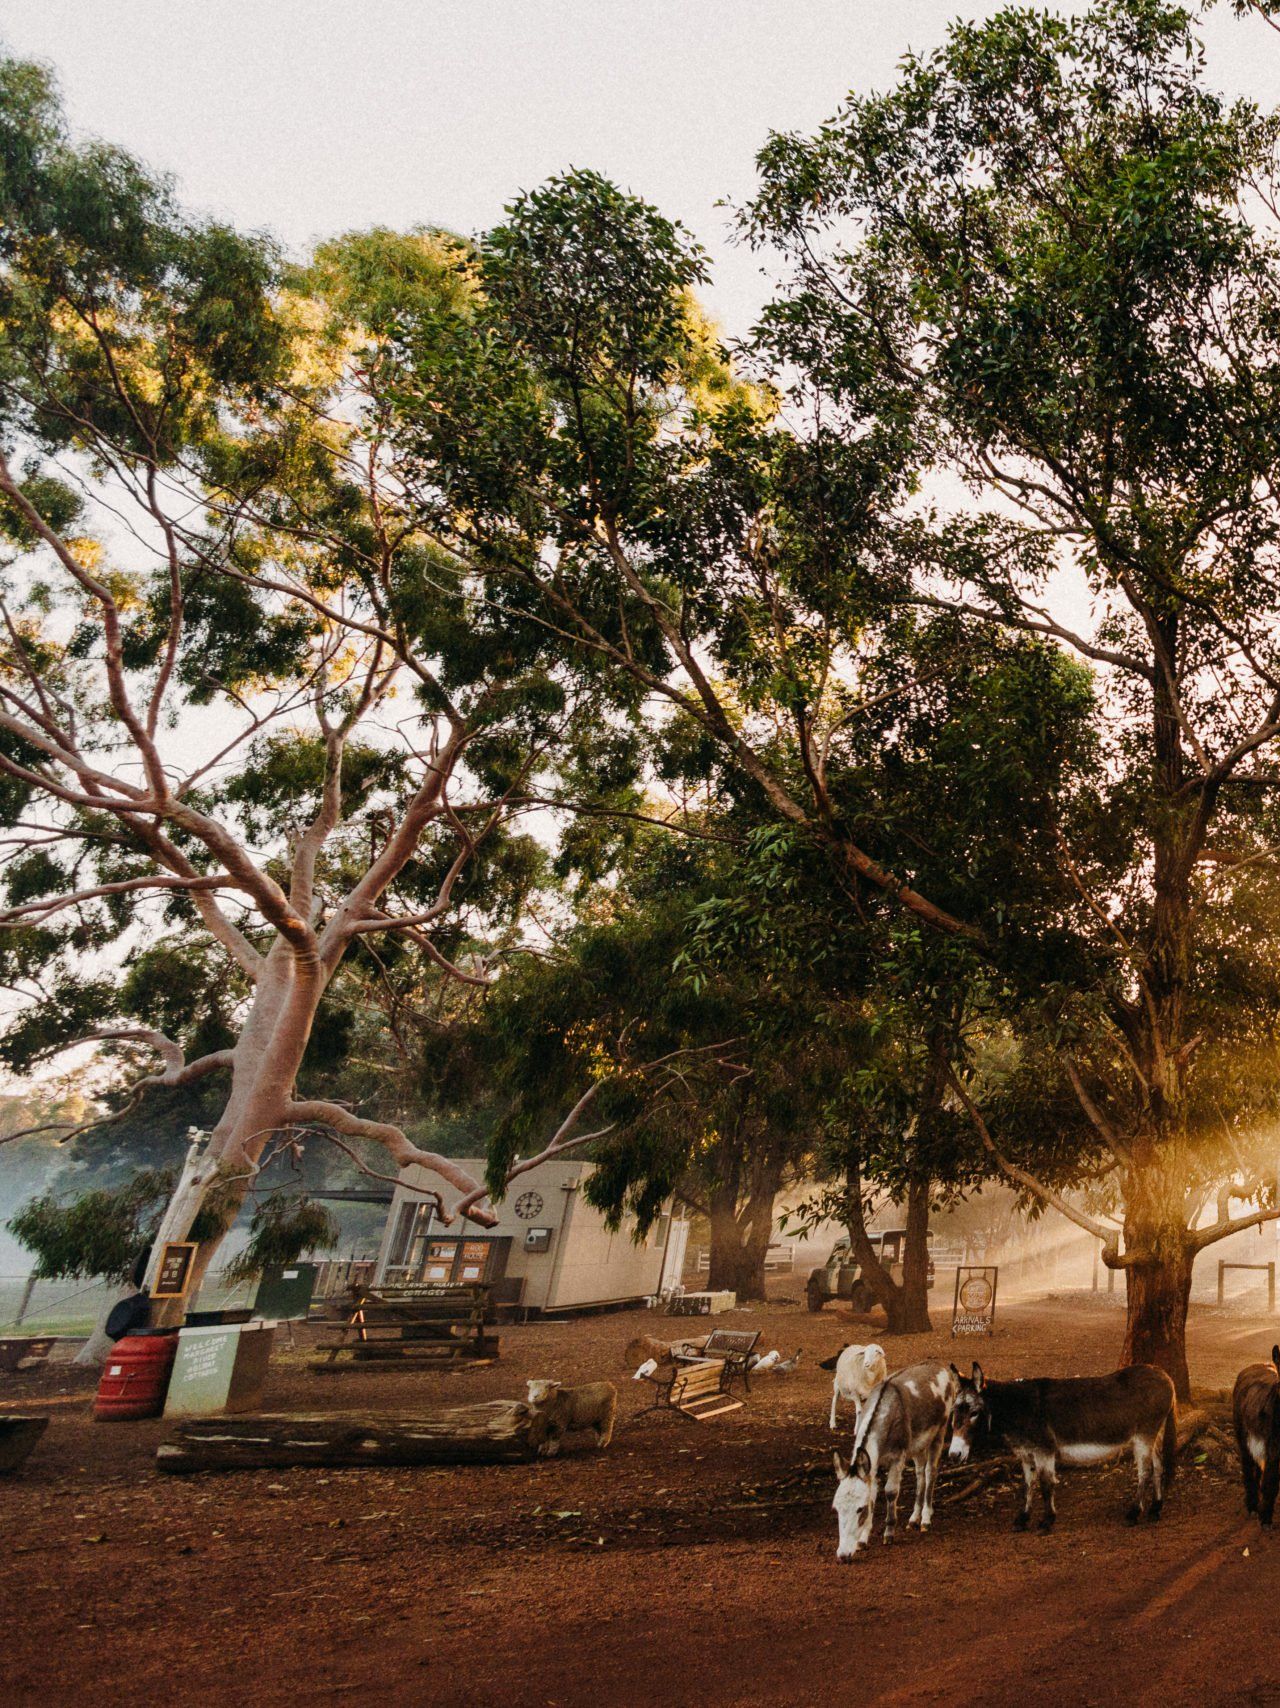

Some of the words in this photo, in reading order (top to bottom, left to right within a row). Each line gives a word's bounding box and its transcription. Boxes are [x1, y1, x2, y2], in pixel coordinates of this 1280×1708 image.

[954, 1315, 991, 1325] ARRIVALS
[957, 1324, 987, 1332] PARKING
[184, 1335, 227, 1352] WELCOME
